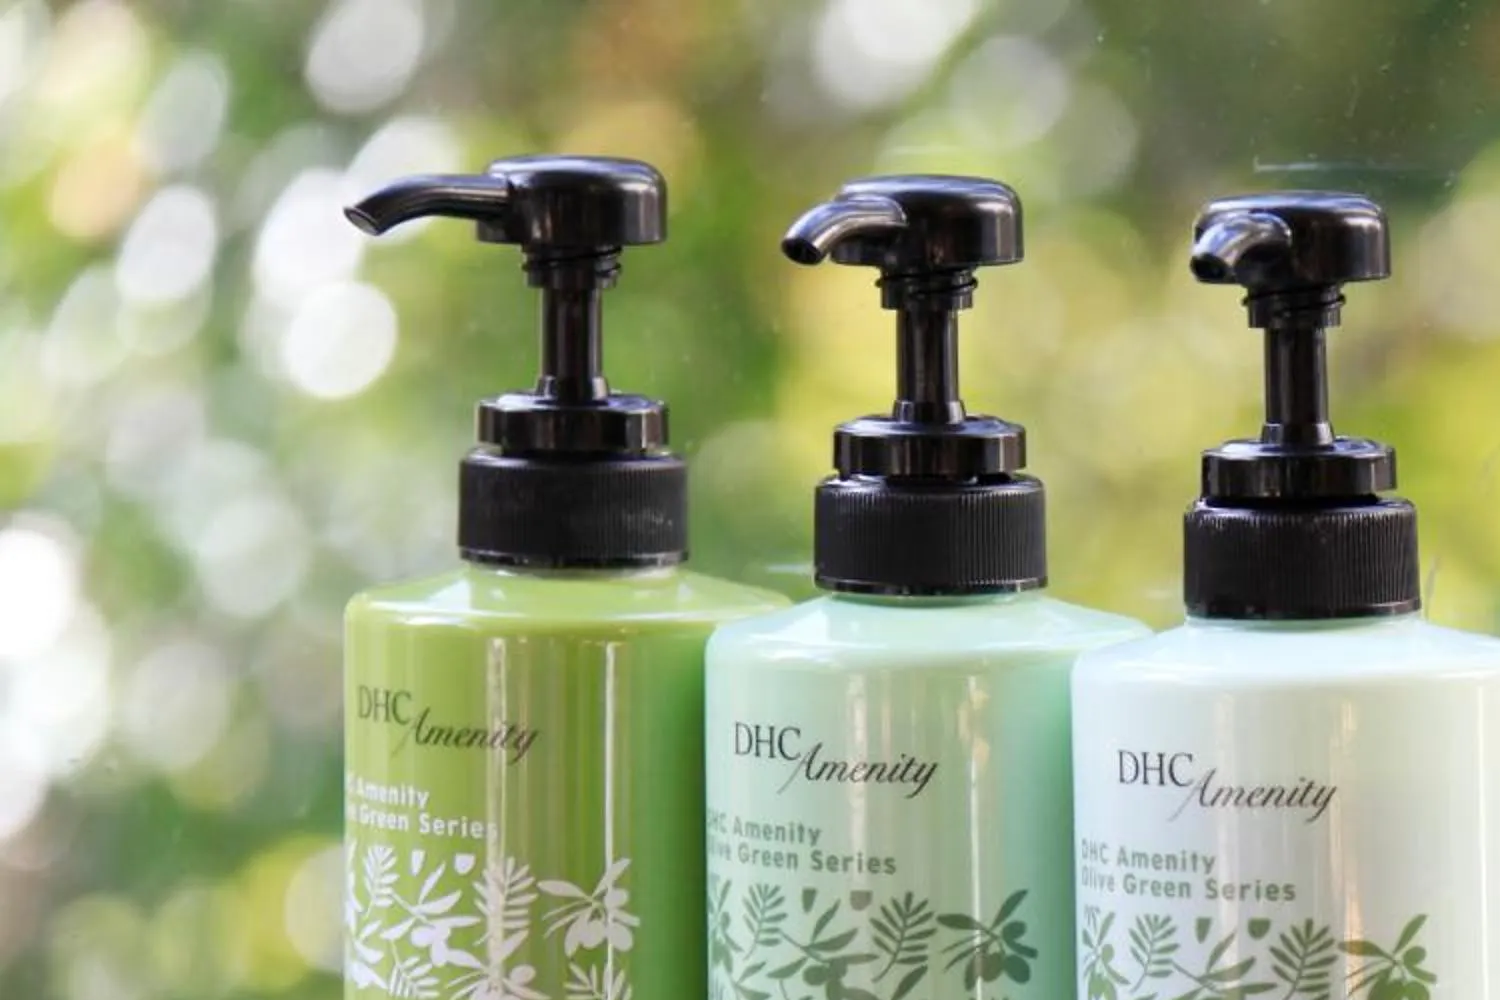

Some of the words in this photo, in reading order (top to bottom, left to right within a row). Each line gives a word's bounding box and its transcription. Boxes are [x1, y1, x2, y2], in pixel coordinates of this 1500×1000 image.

[357, 685, 413, 726] DHC
[392, 708, 540, 766] Amenity
[734, 721, 801, 762] DHC
[776, 742, 939, 799] Amenity
[1117, 749, 1195, 788] DHC
[1167, 768, 1338, 823] Amenity
[418, 812, 498, 841] Series
[733, 816, 823, 847] Amenity
[738, 842, 799, 871] Green
[809, 849, 897, 876] Series
[1081, 838, 1109, 865] DHC
[1116, 844, 1217, 876] Amenity
[1081, 865, 1115, 893] Olive
[1122, 873, 1192, 899] Green
[1205, 878, 1297, 903] Series
